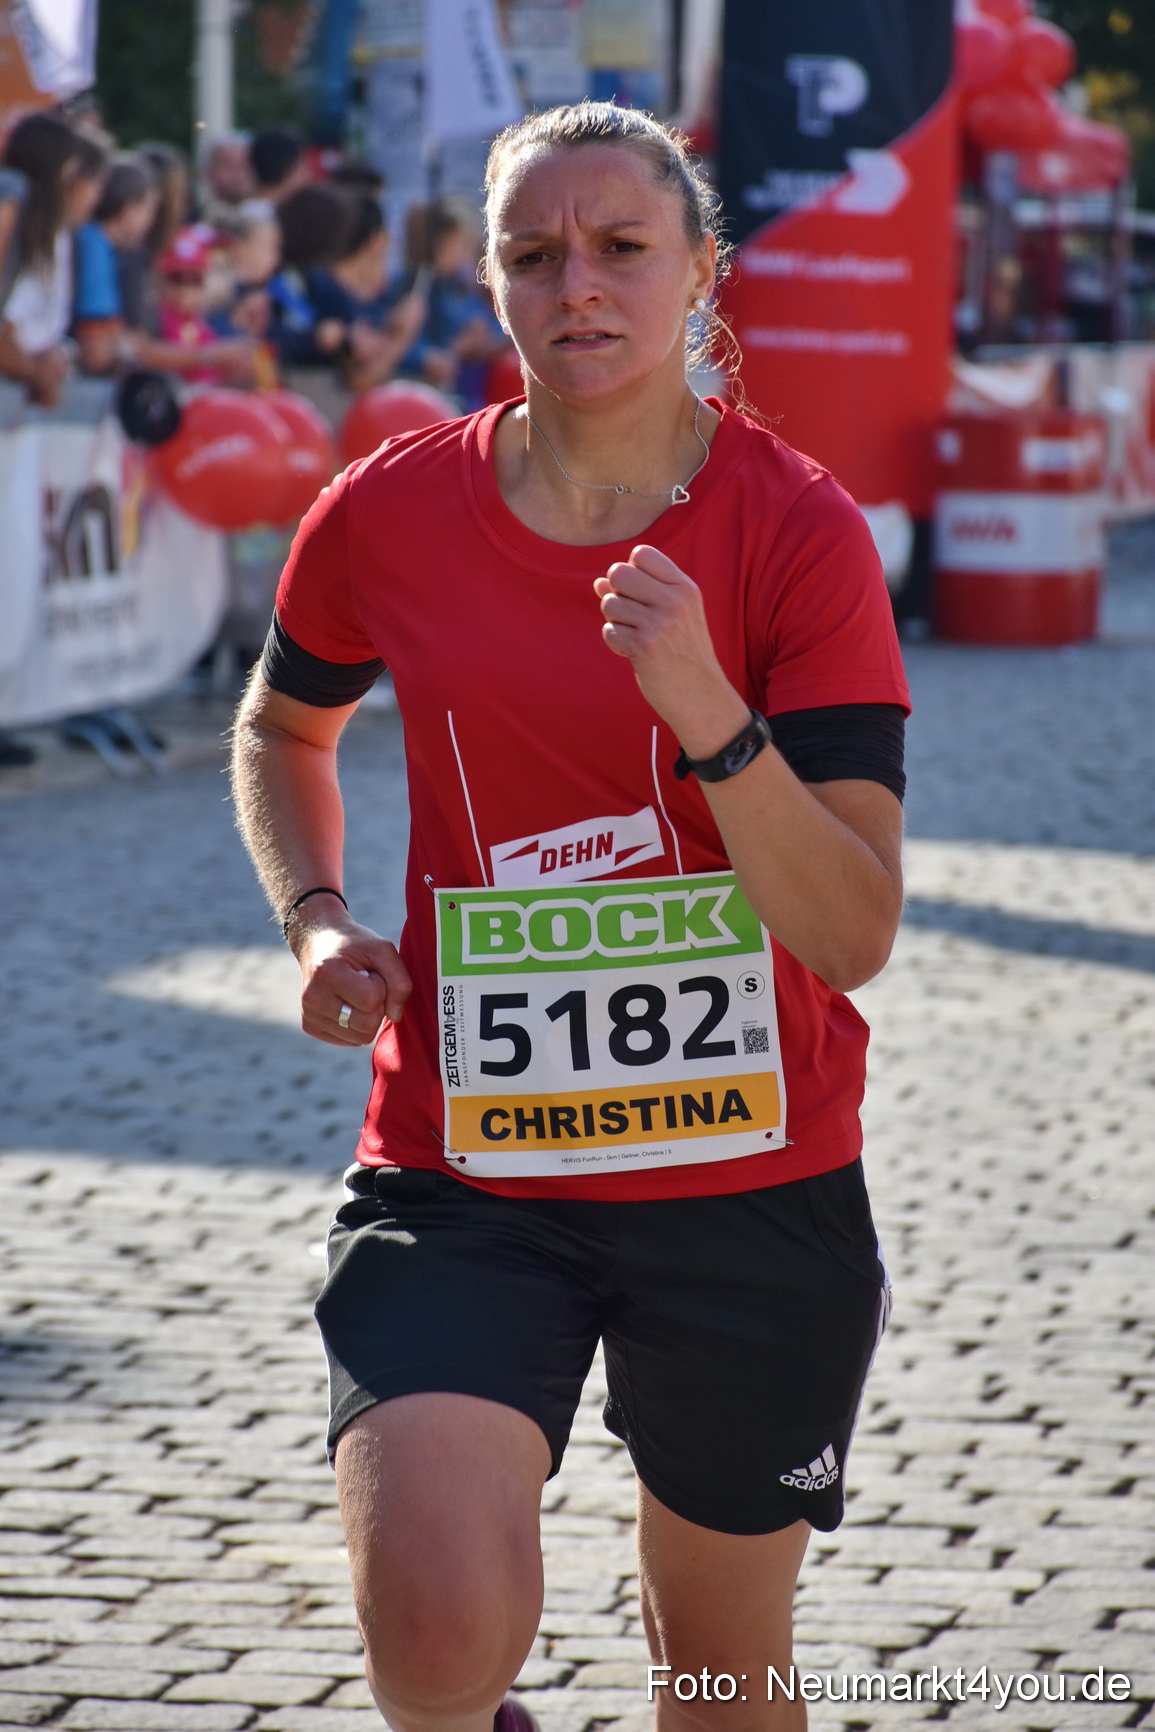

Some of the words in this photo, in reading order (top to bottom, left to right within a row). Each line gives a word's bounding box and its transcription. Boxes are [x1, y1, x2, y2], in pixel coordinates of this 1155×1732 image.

[540, 831, 614, 874] DEHN
[464, 890, 734, 960] BOCK
[744, 977, 758, 993] S
[480, 975, 736, 1077] 5182
[461, 1038, 470, 1086] TRANSPONDER
[480, 1089, 752, 1141] CHRISTINA
[779, 1465, 839, 1491] adidas
